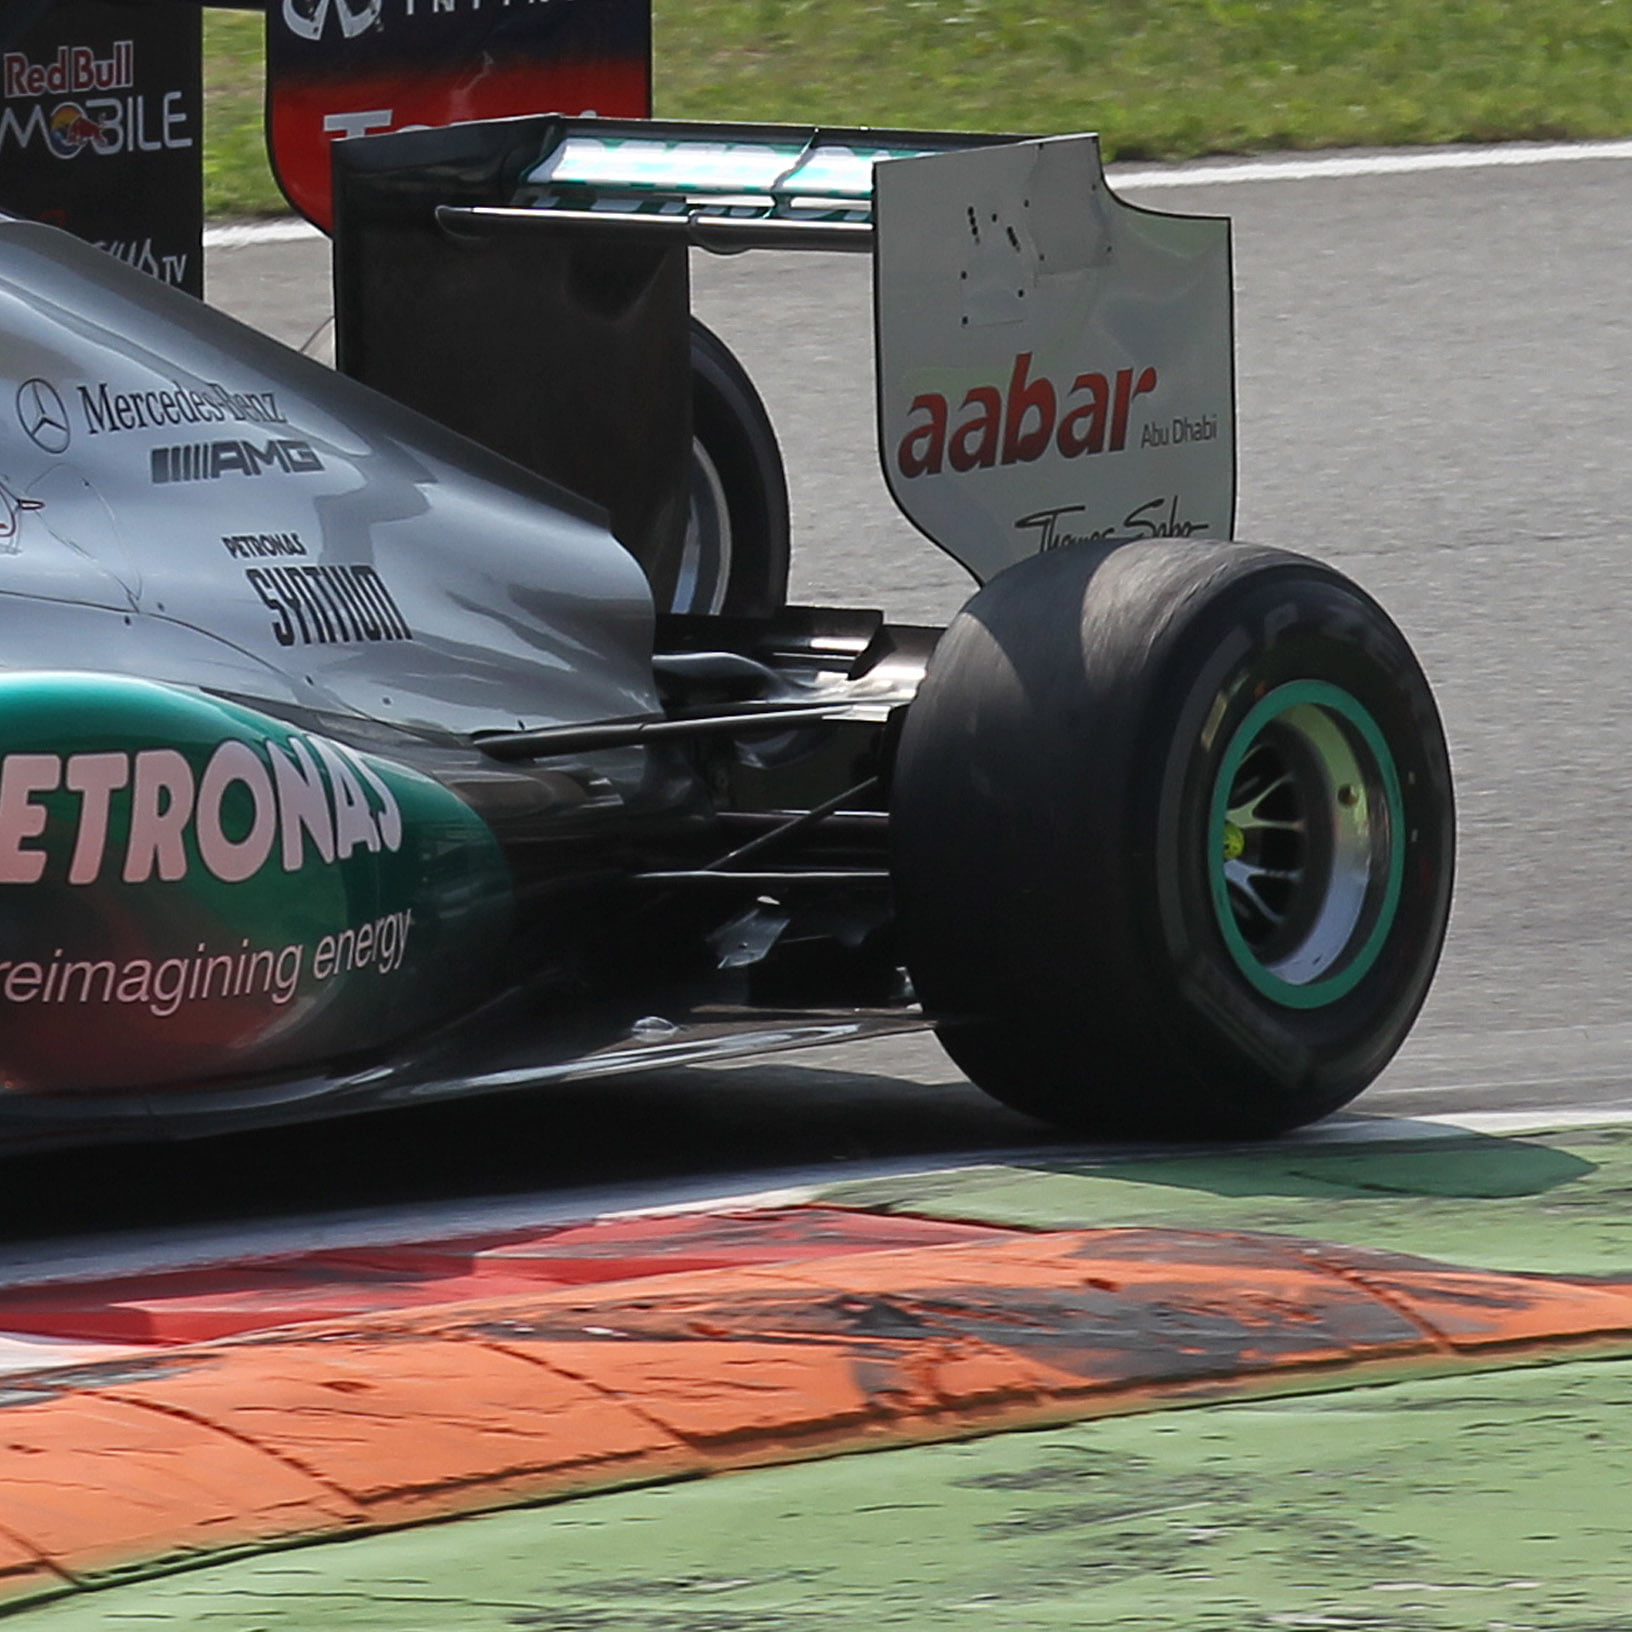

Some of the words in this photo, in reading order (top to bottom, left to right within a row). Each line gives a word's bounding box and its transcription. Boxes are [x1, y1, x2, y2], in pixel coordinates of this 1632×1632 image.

[3, 45, 69, 98] Red
[71, 39, 134, 92] Bull
[77, 380, 288, 436] Mercedes-Benz
[897, 351, 1158, 480] aabar
[1140, 420, 1170, 449] Abu
[1172, 413, 1218, 445] Dhabi
[221, 532, 308, 560] PETRONAS
[245, 564, 414, 648] SYNTIUM
[312, 906, 412, 973] energy
